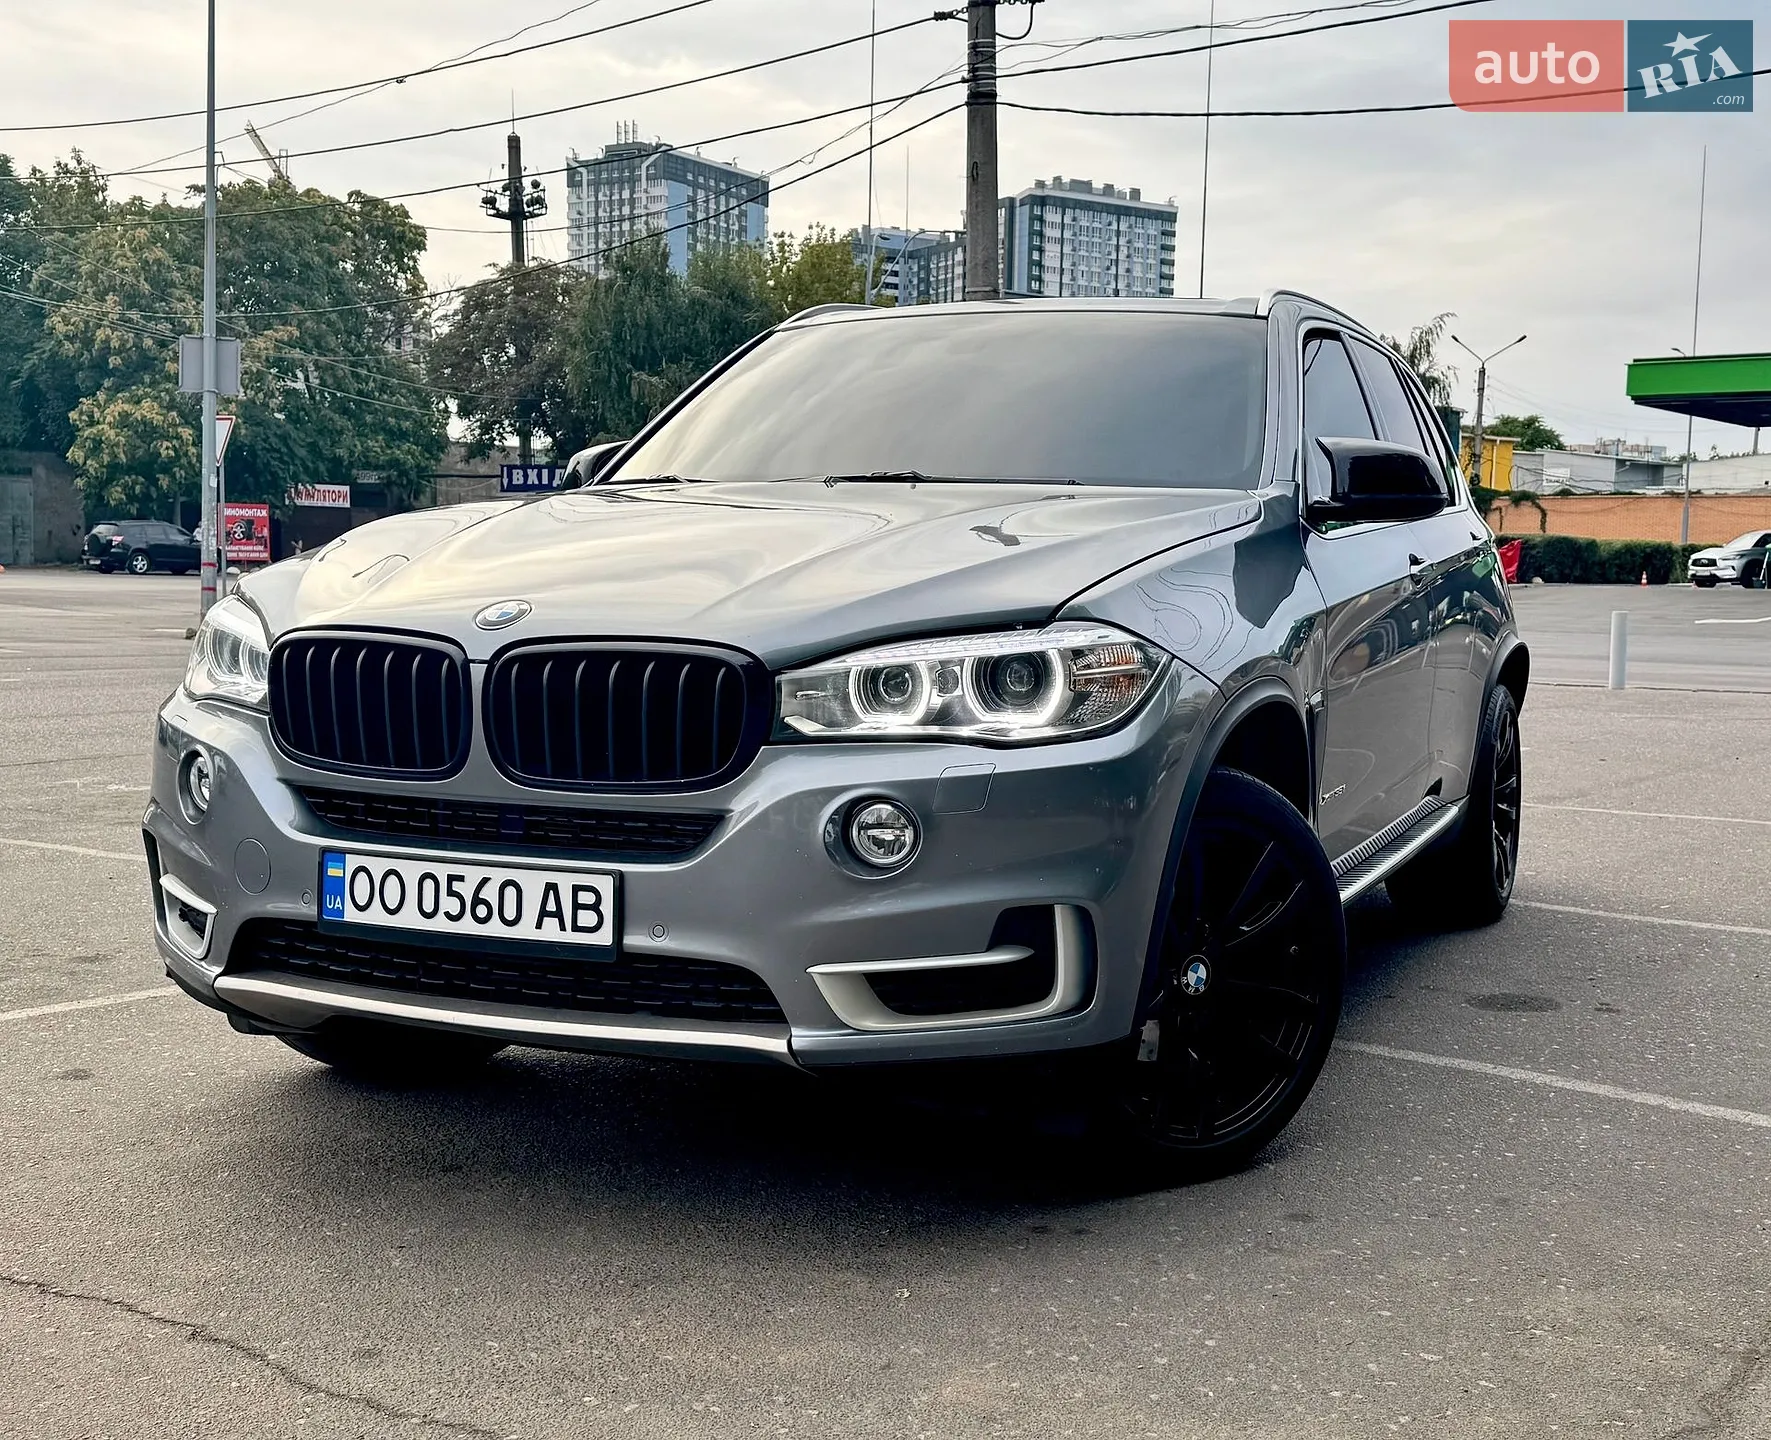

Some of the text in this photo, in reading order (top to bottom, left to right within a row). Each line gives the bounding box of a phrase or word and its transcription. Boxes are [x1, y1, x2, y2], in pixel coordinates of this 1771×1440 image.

[326, 893, 343, 911] UA
[416, 870, 523, 928] 0560
[534, 880, 605, 934] AB
